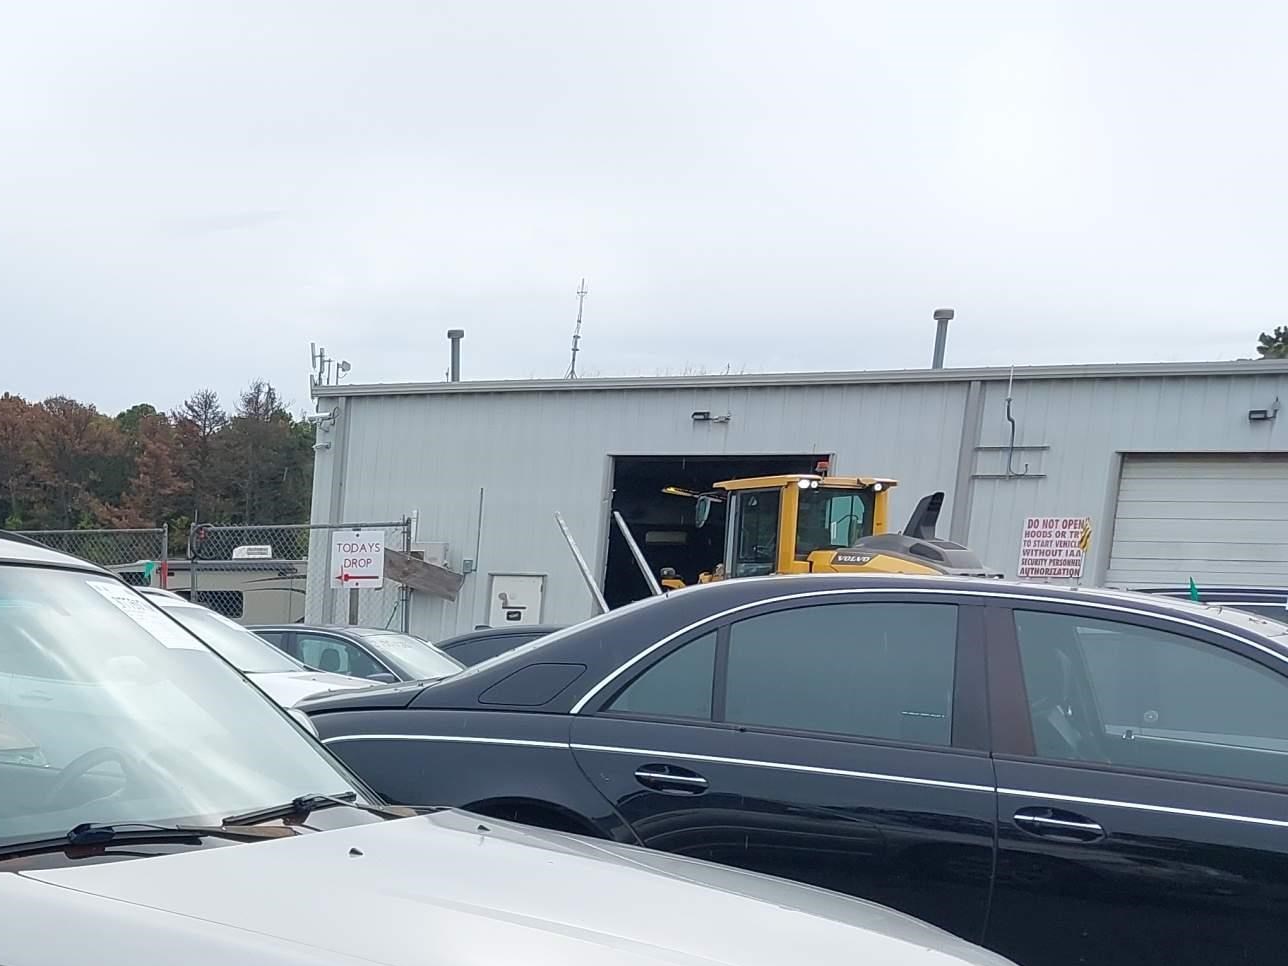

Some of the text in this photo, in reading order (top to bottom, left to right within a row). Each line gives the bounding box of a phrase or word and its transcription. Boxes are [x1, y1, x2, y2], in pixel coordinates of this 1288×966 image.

[1028, 519, 1085, 529] DO NOT OPEN
[1024, 530, 1052, 538] HOODS
[1055, 530, 1066, 538] OR
[337, 543, 380, 553] TODAYS
[1023, 539, 1032, 548] TO
[1033, 540, 1053, 548] START
[1022, 549, 1081, 557] WITHOUT IAA
[343, 558, 372, 568] DROP
[1021, 558, 1081, 567] SECURITY PERSONNEL
[1020, 567, 1080, 576] AUTHORIZATION
